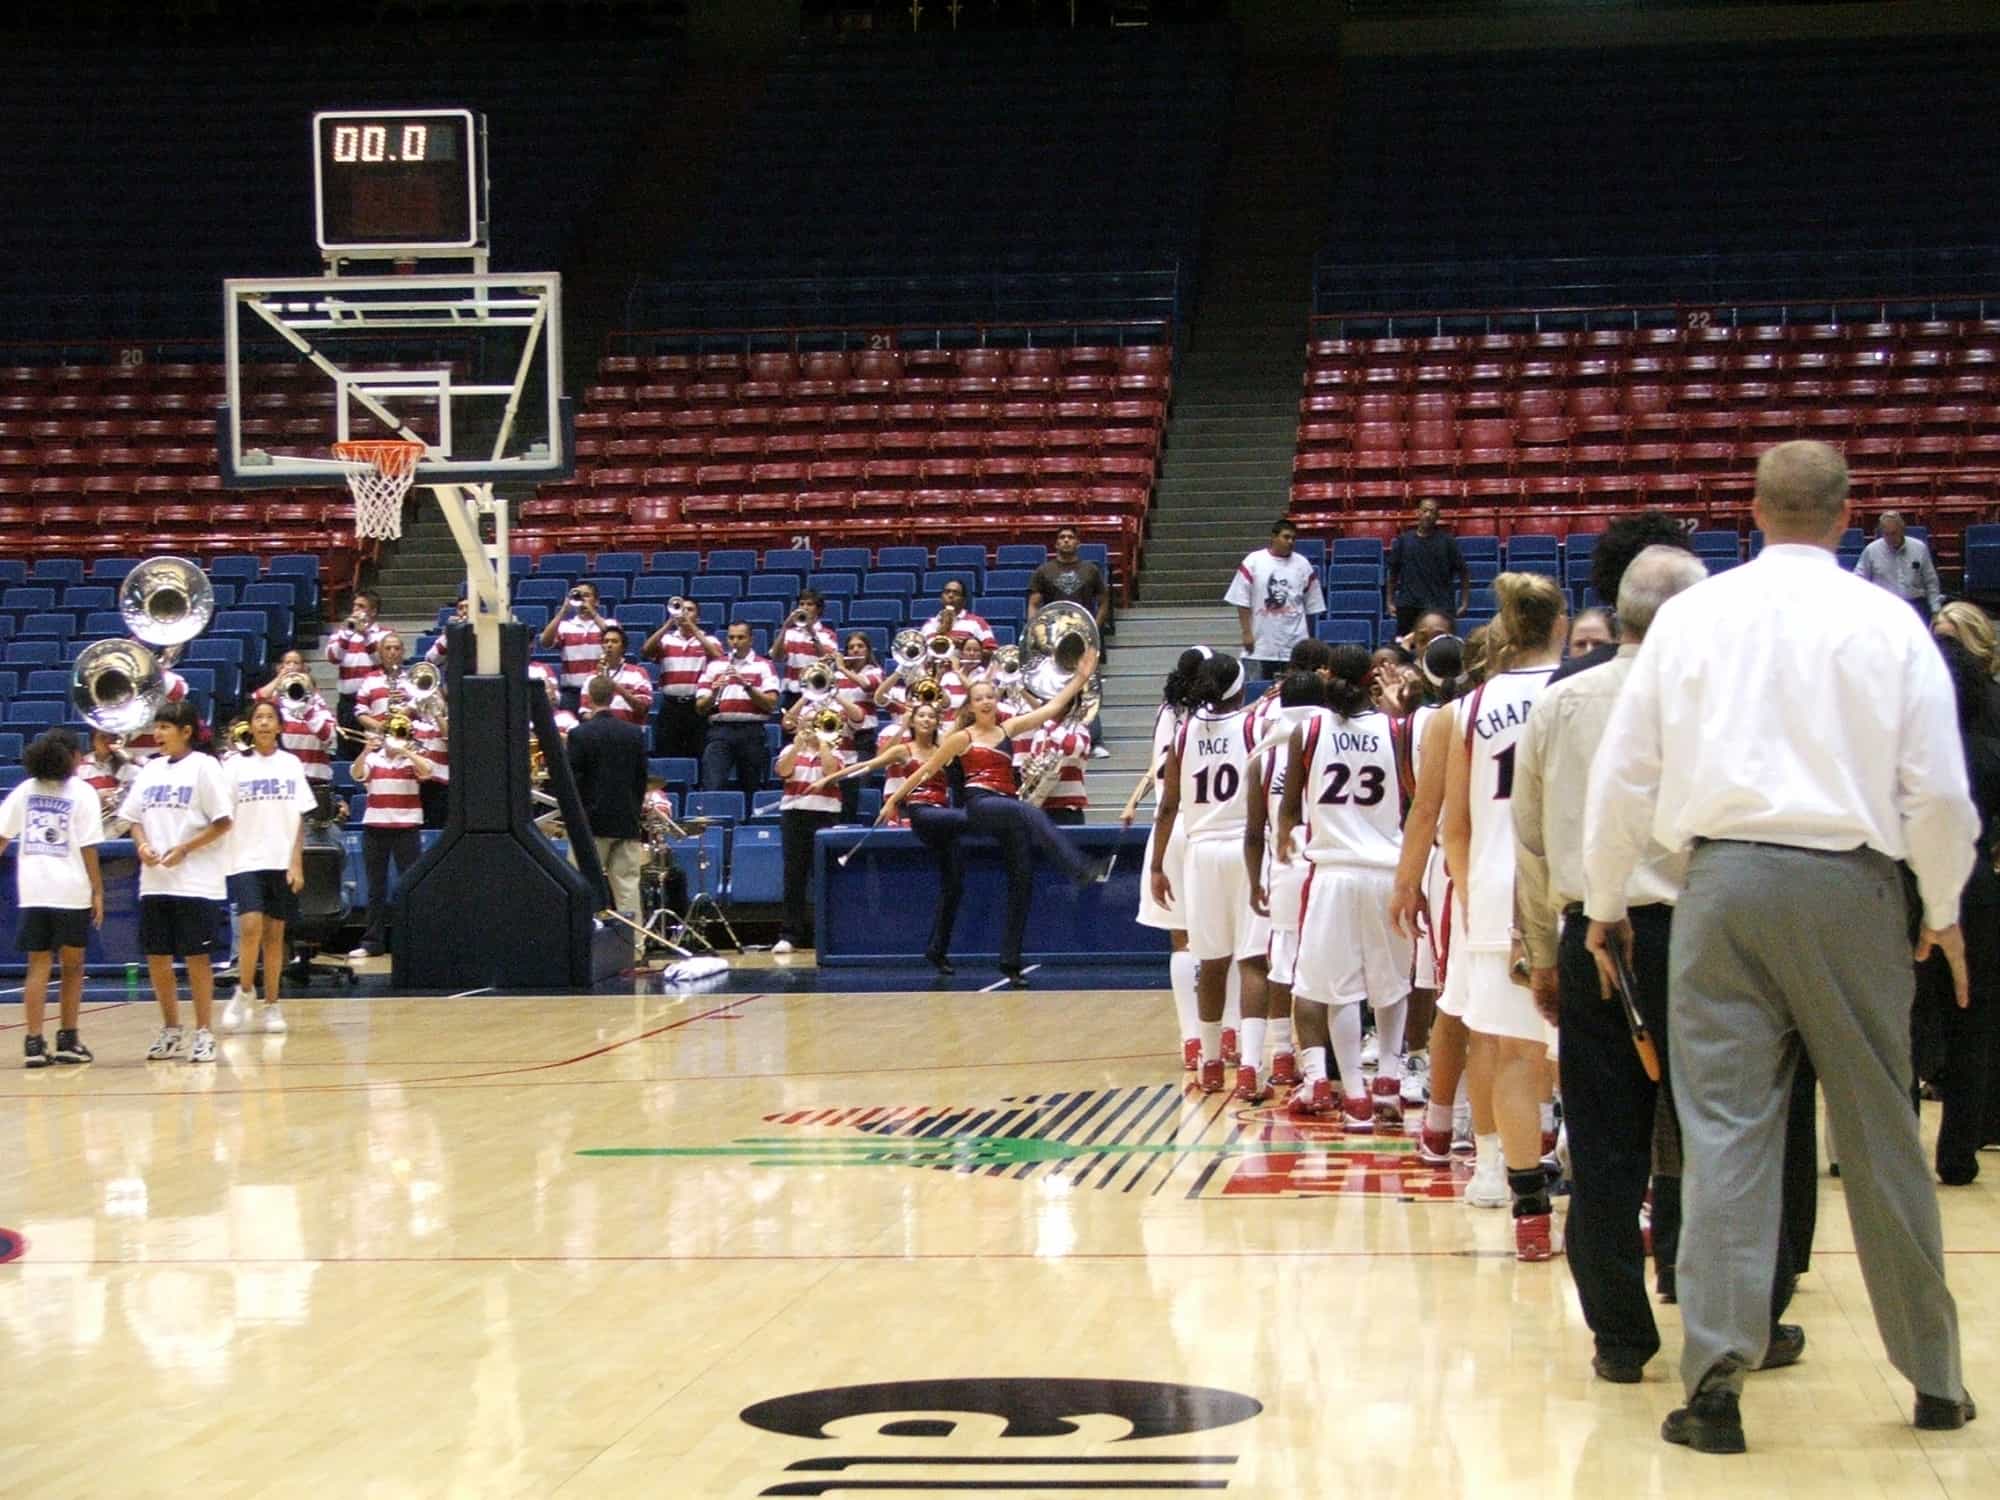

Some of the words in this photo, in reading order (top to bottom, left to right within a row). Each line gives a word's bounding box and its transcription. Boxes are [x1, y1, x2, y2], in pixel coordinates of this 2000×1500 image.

[333, 125, 427, 162] 00.0
[1688, 311, 1711, 329] 22
[871, 334, 891, 350] 21
[120, 349, 144, 367] 20
[791, 535, 811, 551] 21
[1198, 737, 1229, 756] PACE
[1332, 732, 1380, 755] JONES
[1192, 763, 1239, 804] 10
[1317, 762, 1386, 806] 23
